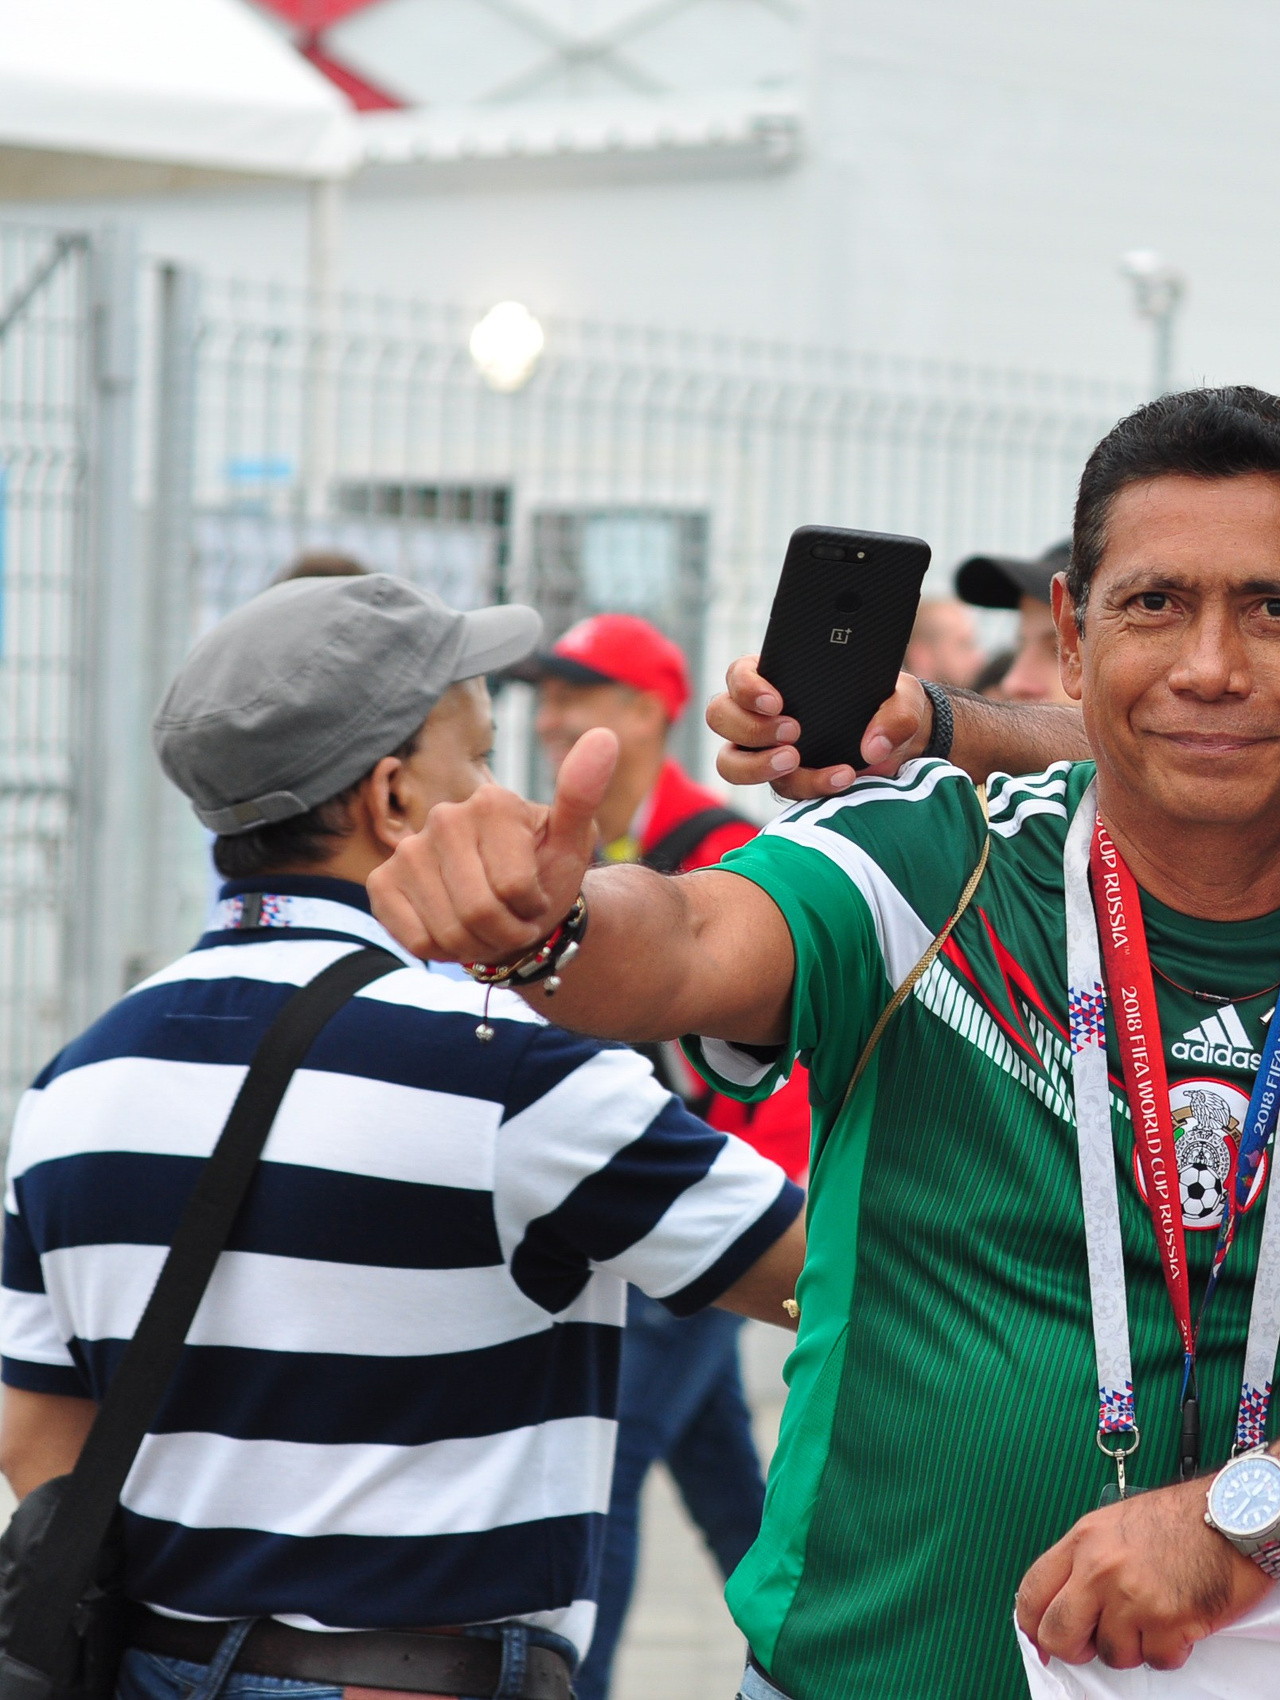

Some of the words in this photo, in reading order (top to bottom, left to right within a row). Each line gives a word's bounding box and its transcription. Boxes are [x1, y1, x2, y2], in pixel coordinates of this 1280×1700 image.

[1098, 829, 1117, 868] CUP
[1121, 986, 1143, 1032] 2018
[1129, 1035, 1149, 1079] FIFA
[1171, 1040, 1262, 1071] adidas
[1137, 1080, 1162, 1154] WORLD
[1254, 1091, 1276, 1136] 2018
[1151, 1158, 1169, 1200] CUP
[1159, 1204, 1180, 1280] RUSSIA
